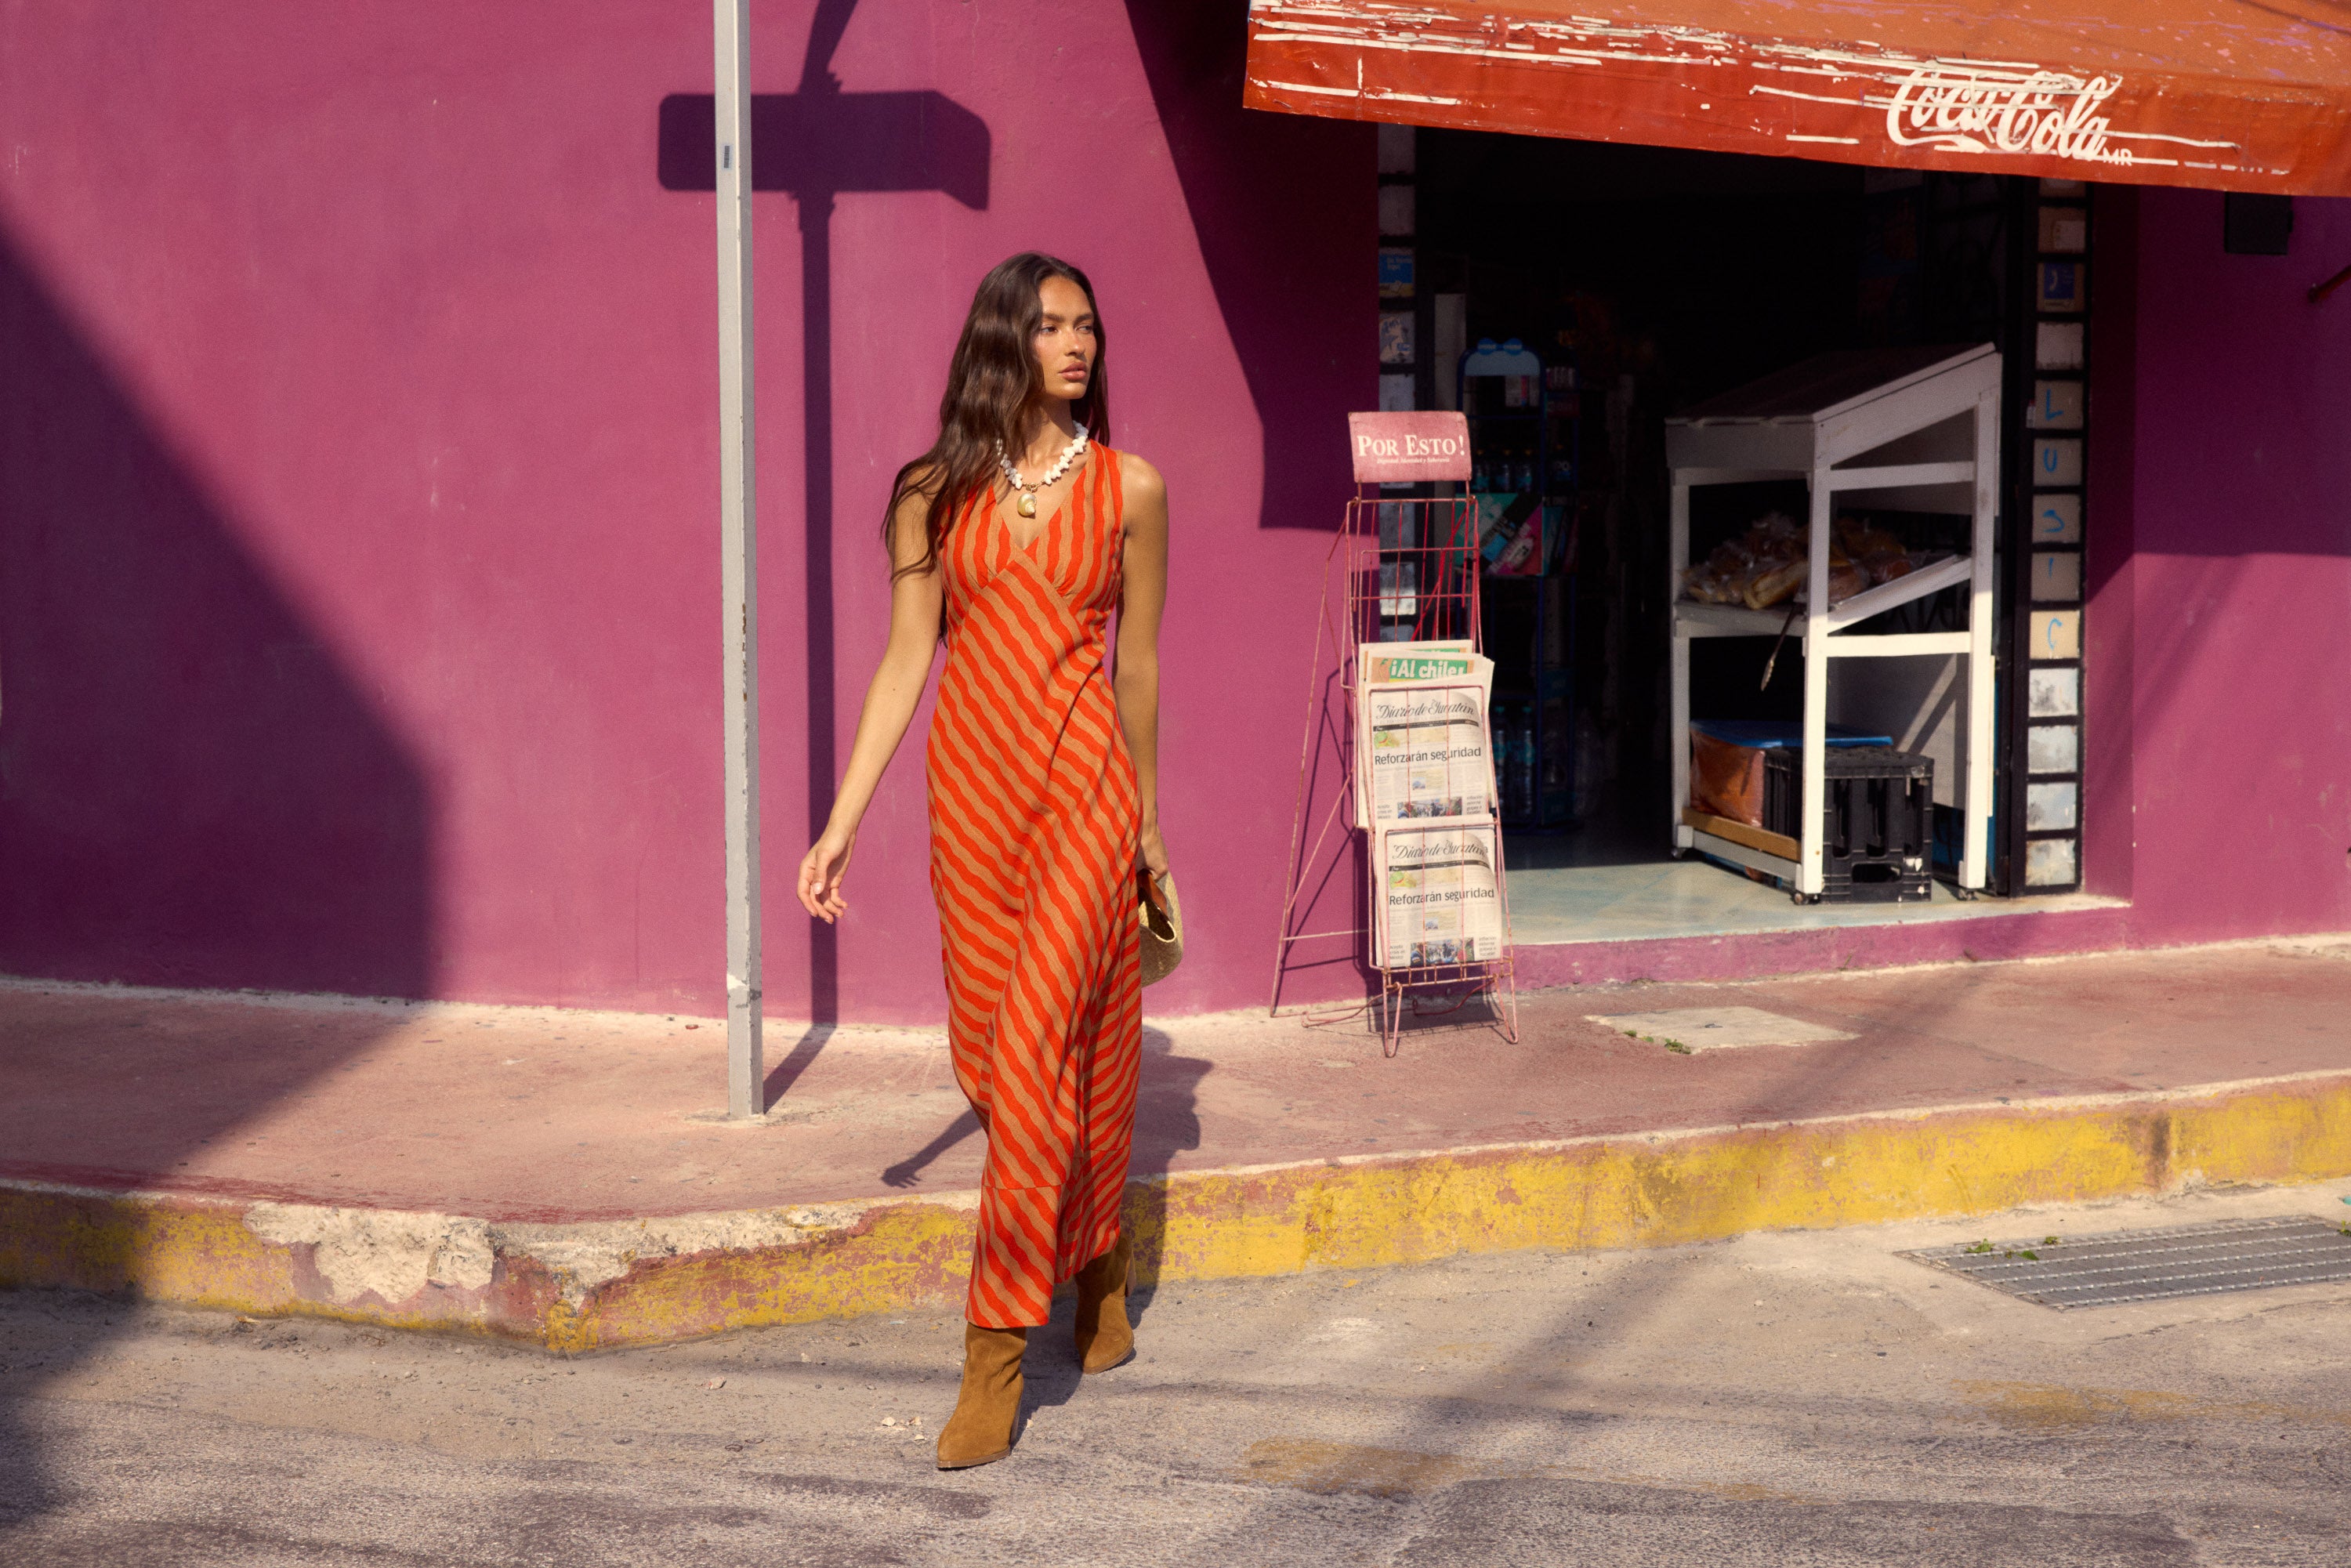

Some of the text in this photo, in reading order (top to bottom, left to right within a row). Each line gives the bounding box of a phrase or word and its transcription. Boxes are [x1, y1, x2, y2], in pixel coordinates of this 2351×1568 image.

[2103, 148, 2132, 166] MR
[1375, 704, 1415, 719] Diario
[1415, 703, 1428, 715] de
[1375, 747, 1481, 766] Reforzarán seguridad
[1392, 845, 1429, 859] Diario
[1389, 888, 1494, 905] Reforzarán seguridad
